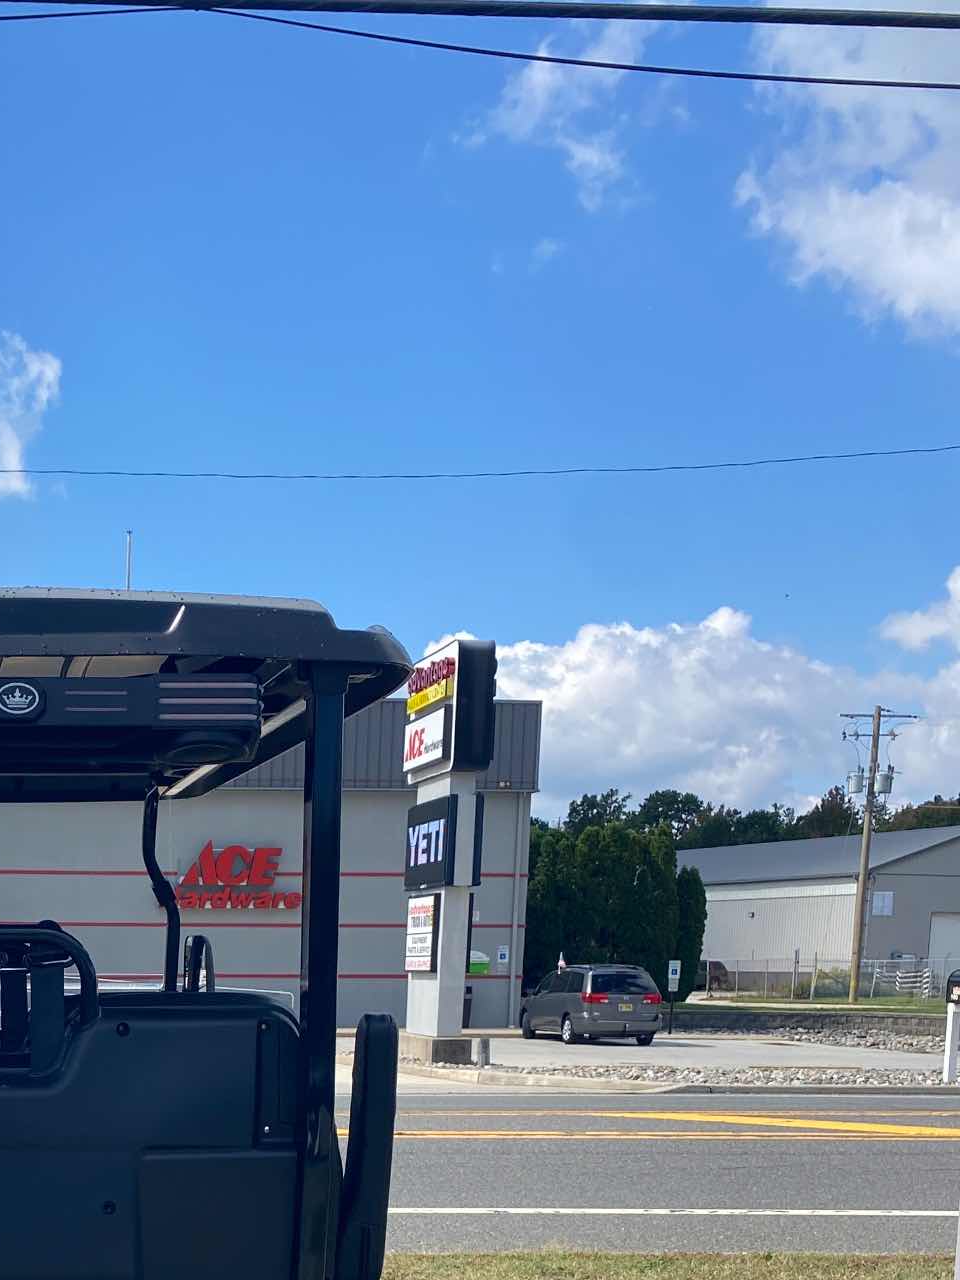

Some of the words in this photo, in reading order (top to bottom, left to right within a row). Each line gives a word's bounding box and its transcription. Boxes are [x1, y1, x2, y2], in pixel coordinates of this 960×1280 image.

[404, 727, 426, 763] ACE
[180, 839, 283, 885] ACE
[408, 818, 446, 867] YETI
